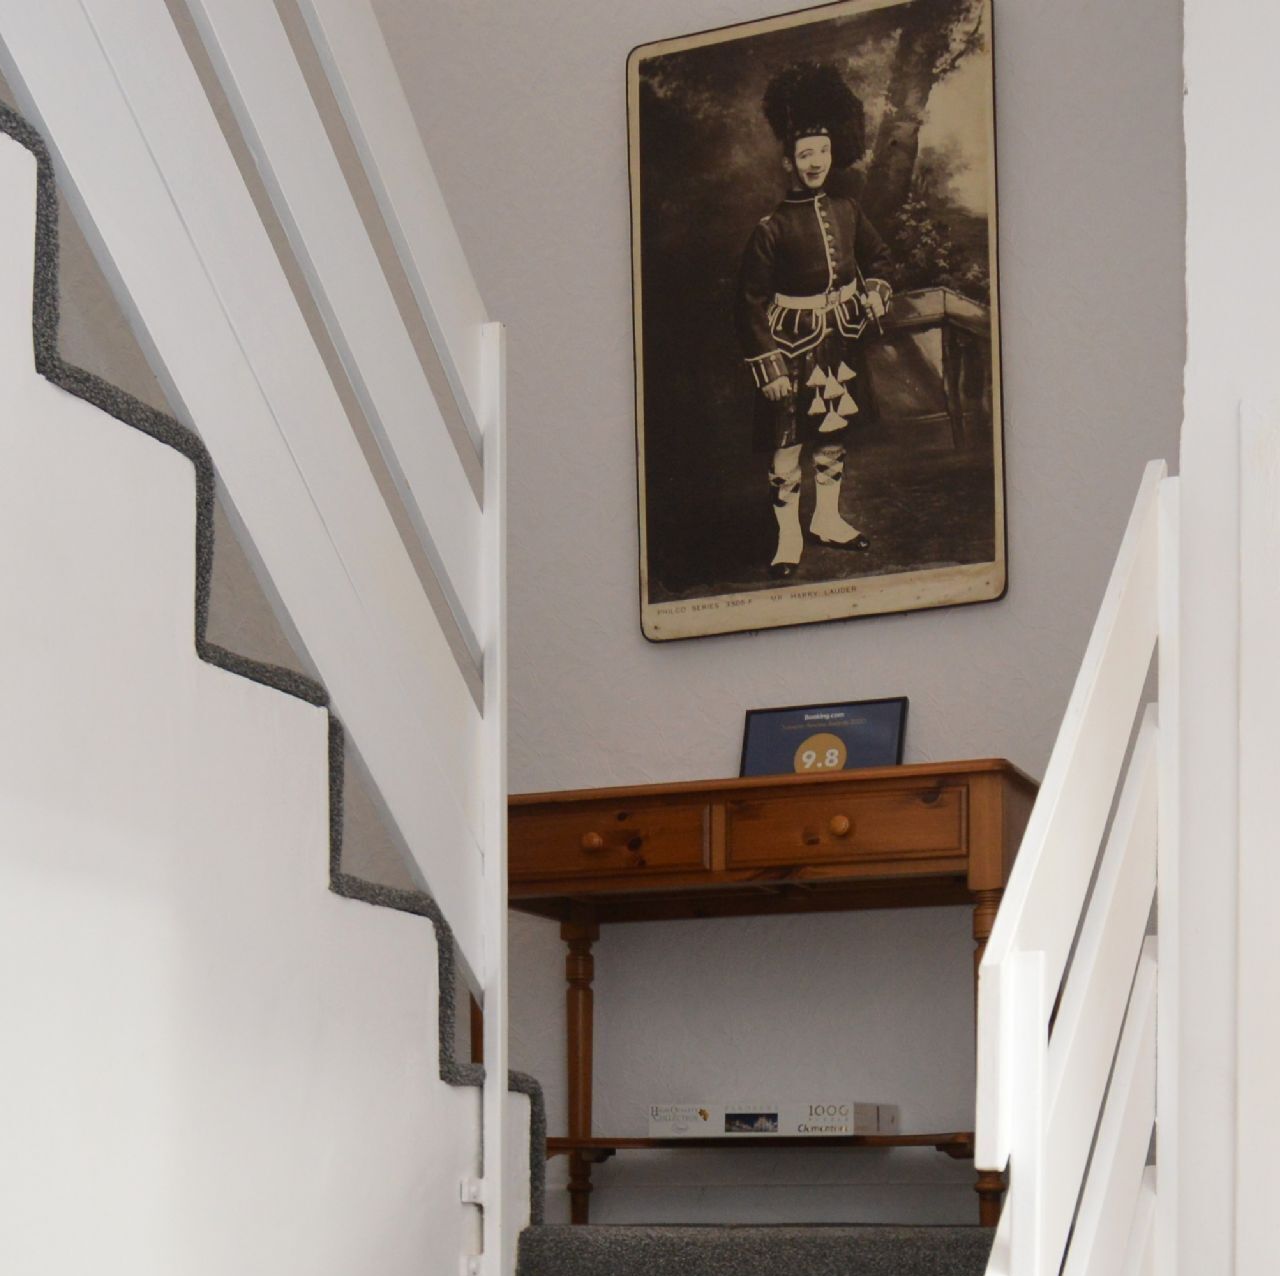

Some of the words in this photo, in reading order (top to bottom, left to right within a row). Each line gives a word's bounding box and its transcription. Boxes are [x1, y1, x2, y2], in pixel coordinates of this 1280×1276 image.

[691, 602, 720, 612] SERIES
[790, 591, 817, 599] HARRY
[824, 585, 857, 597] LAUDER
[801, 748, 840, 769] 9.8
[808, 1104, 849, 1117] 1000
